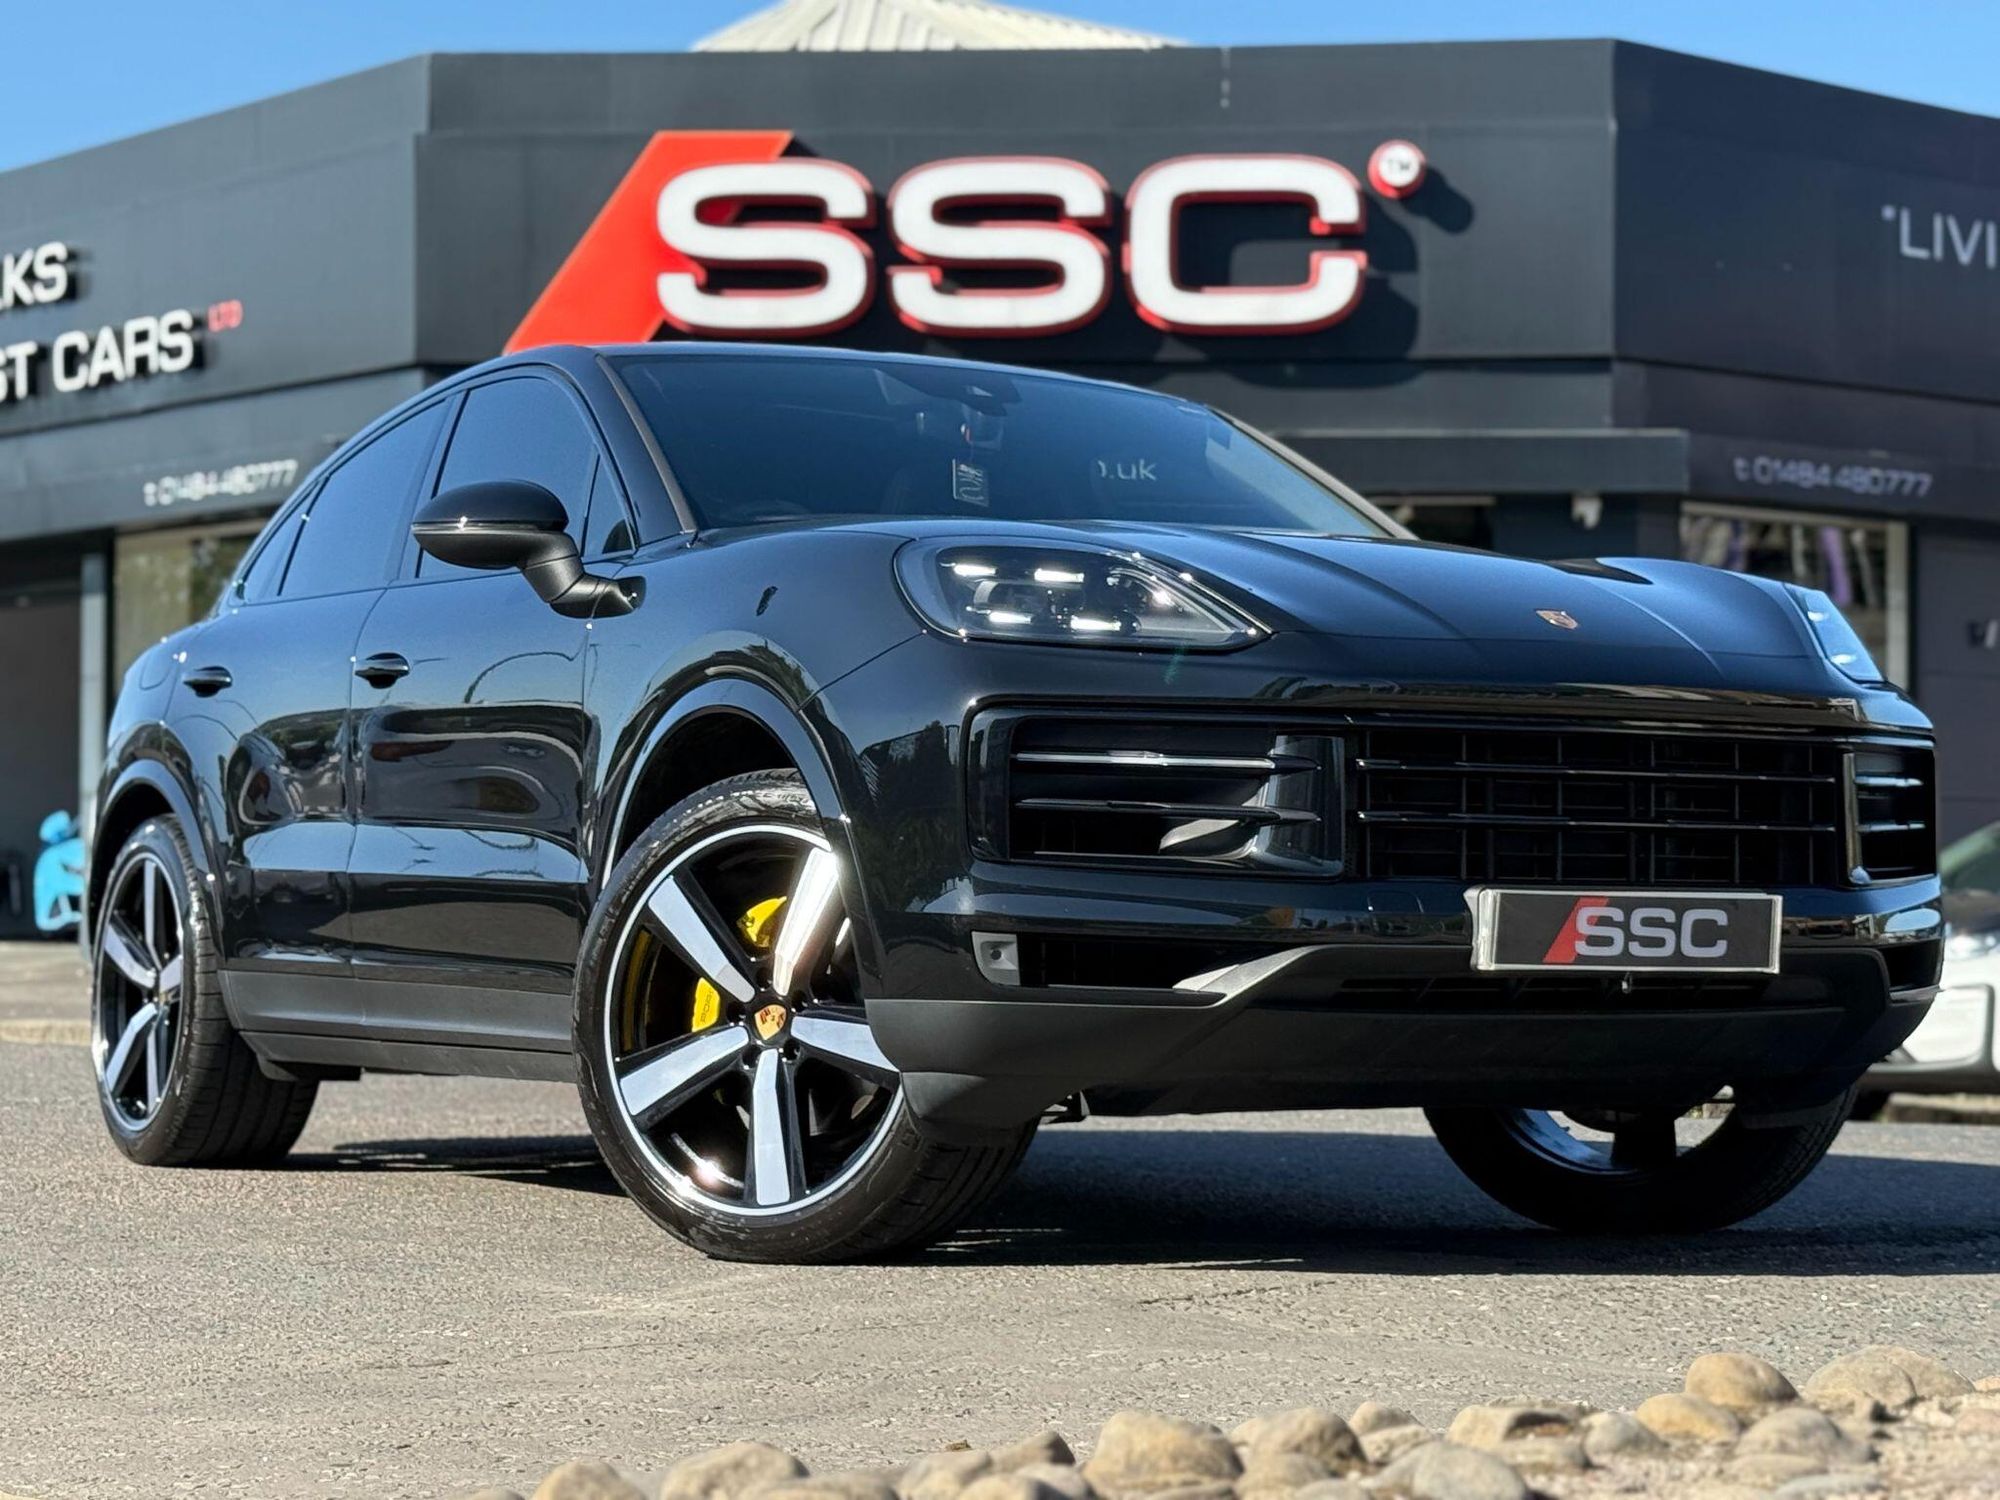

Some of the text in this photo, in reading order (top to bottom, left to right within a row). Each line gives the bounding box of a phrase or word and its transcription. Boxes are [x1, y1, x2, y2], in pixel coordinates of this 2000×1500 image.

[0, 242, 68, 308] KS
[656, 156, 1366, 334] SSC
[52, 309, 194, 392] CARS
[1575, 906, 1729, 957] SSC
